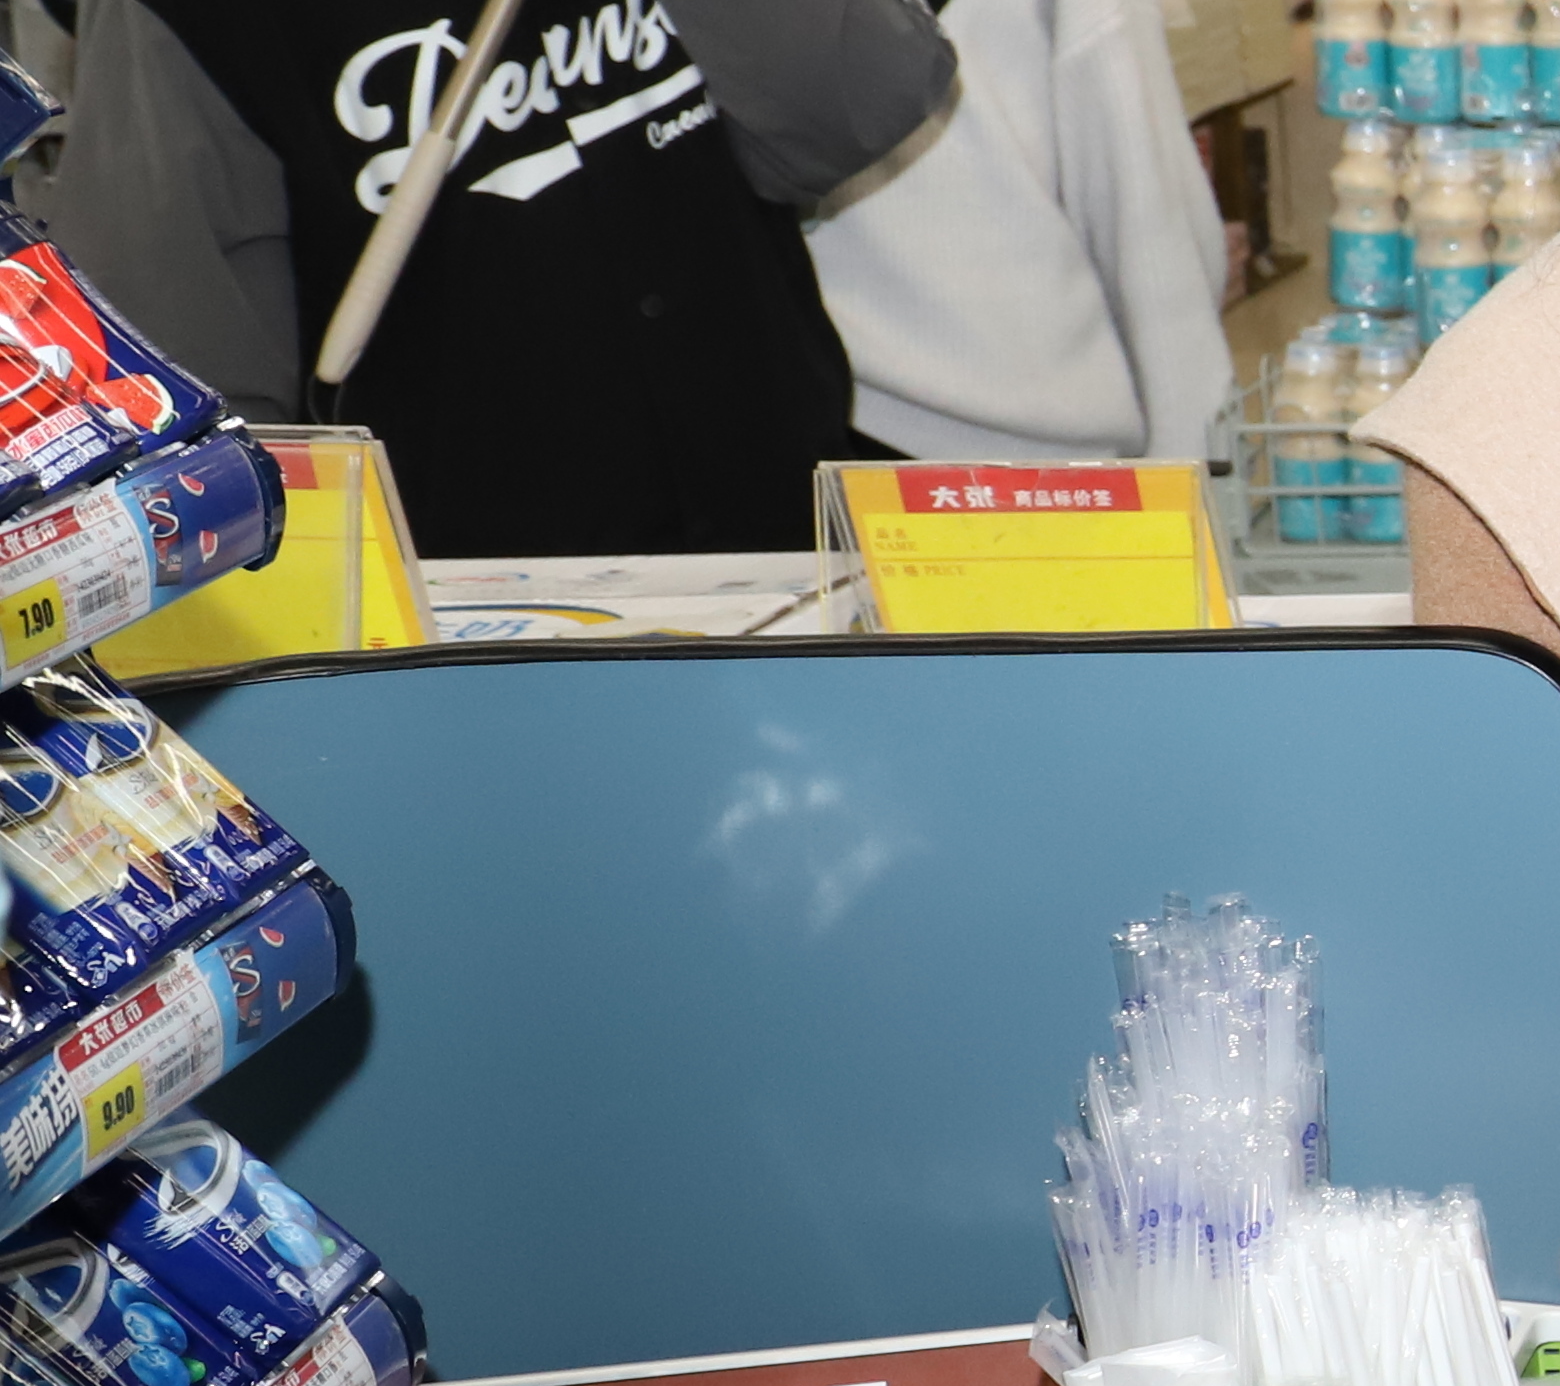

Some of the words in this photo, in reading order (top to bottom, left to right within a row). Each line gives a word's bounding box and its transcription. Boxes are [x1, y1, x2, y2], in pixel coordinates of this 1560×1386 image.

[929, 485, 998, 509] 大张
[1012, 488, 1114, 508] 商品标价签
[18, 598, 55, 640] 7.90
[78, 999, 144, 1057] 大张超市
[101, 1084, 136, 1131] 9.90
